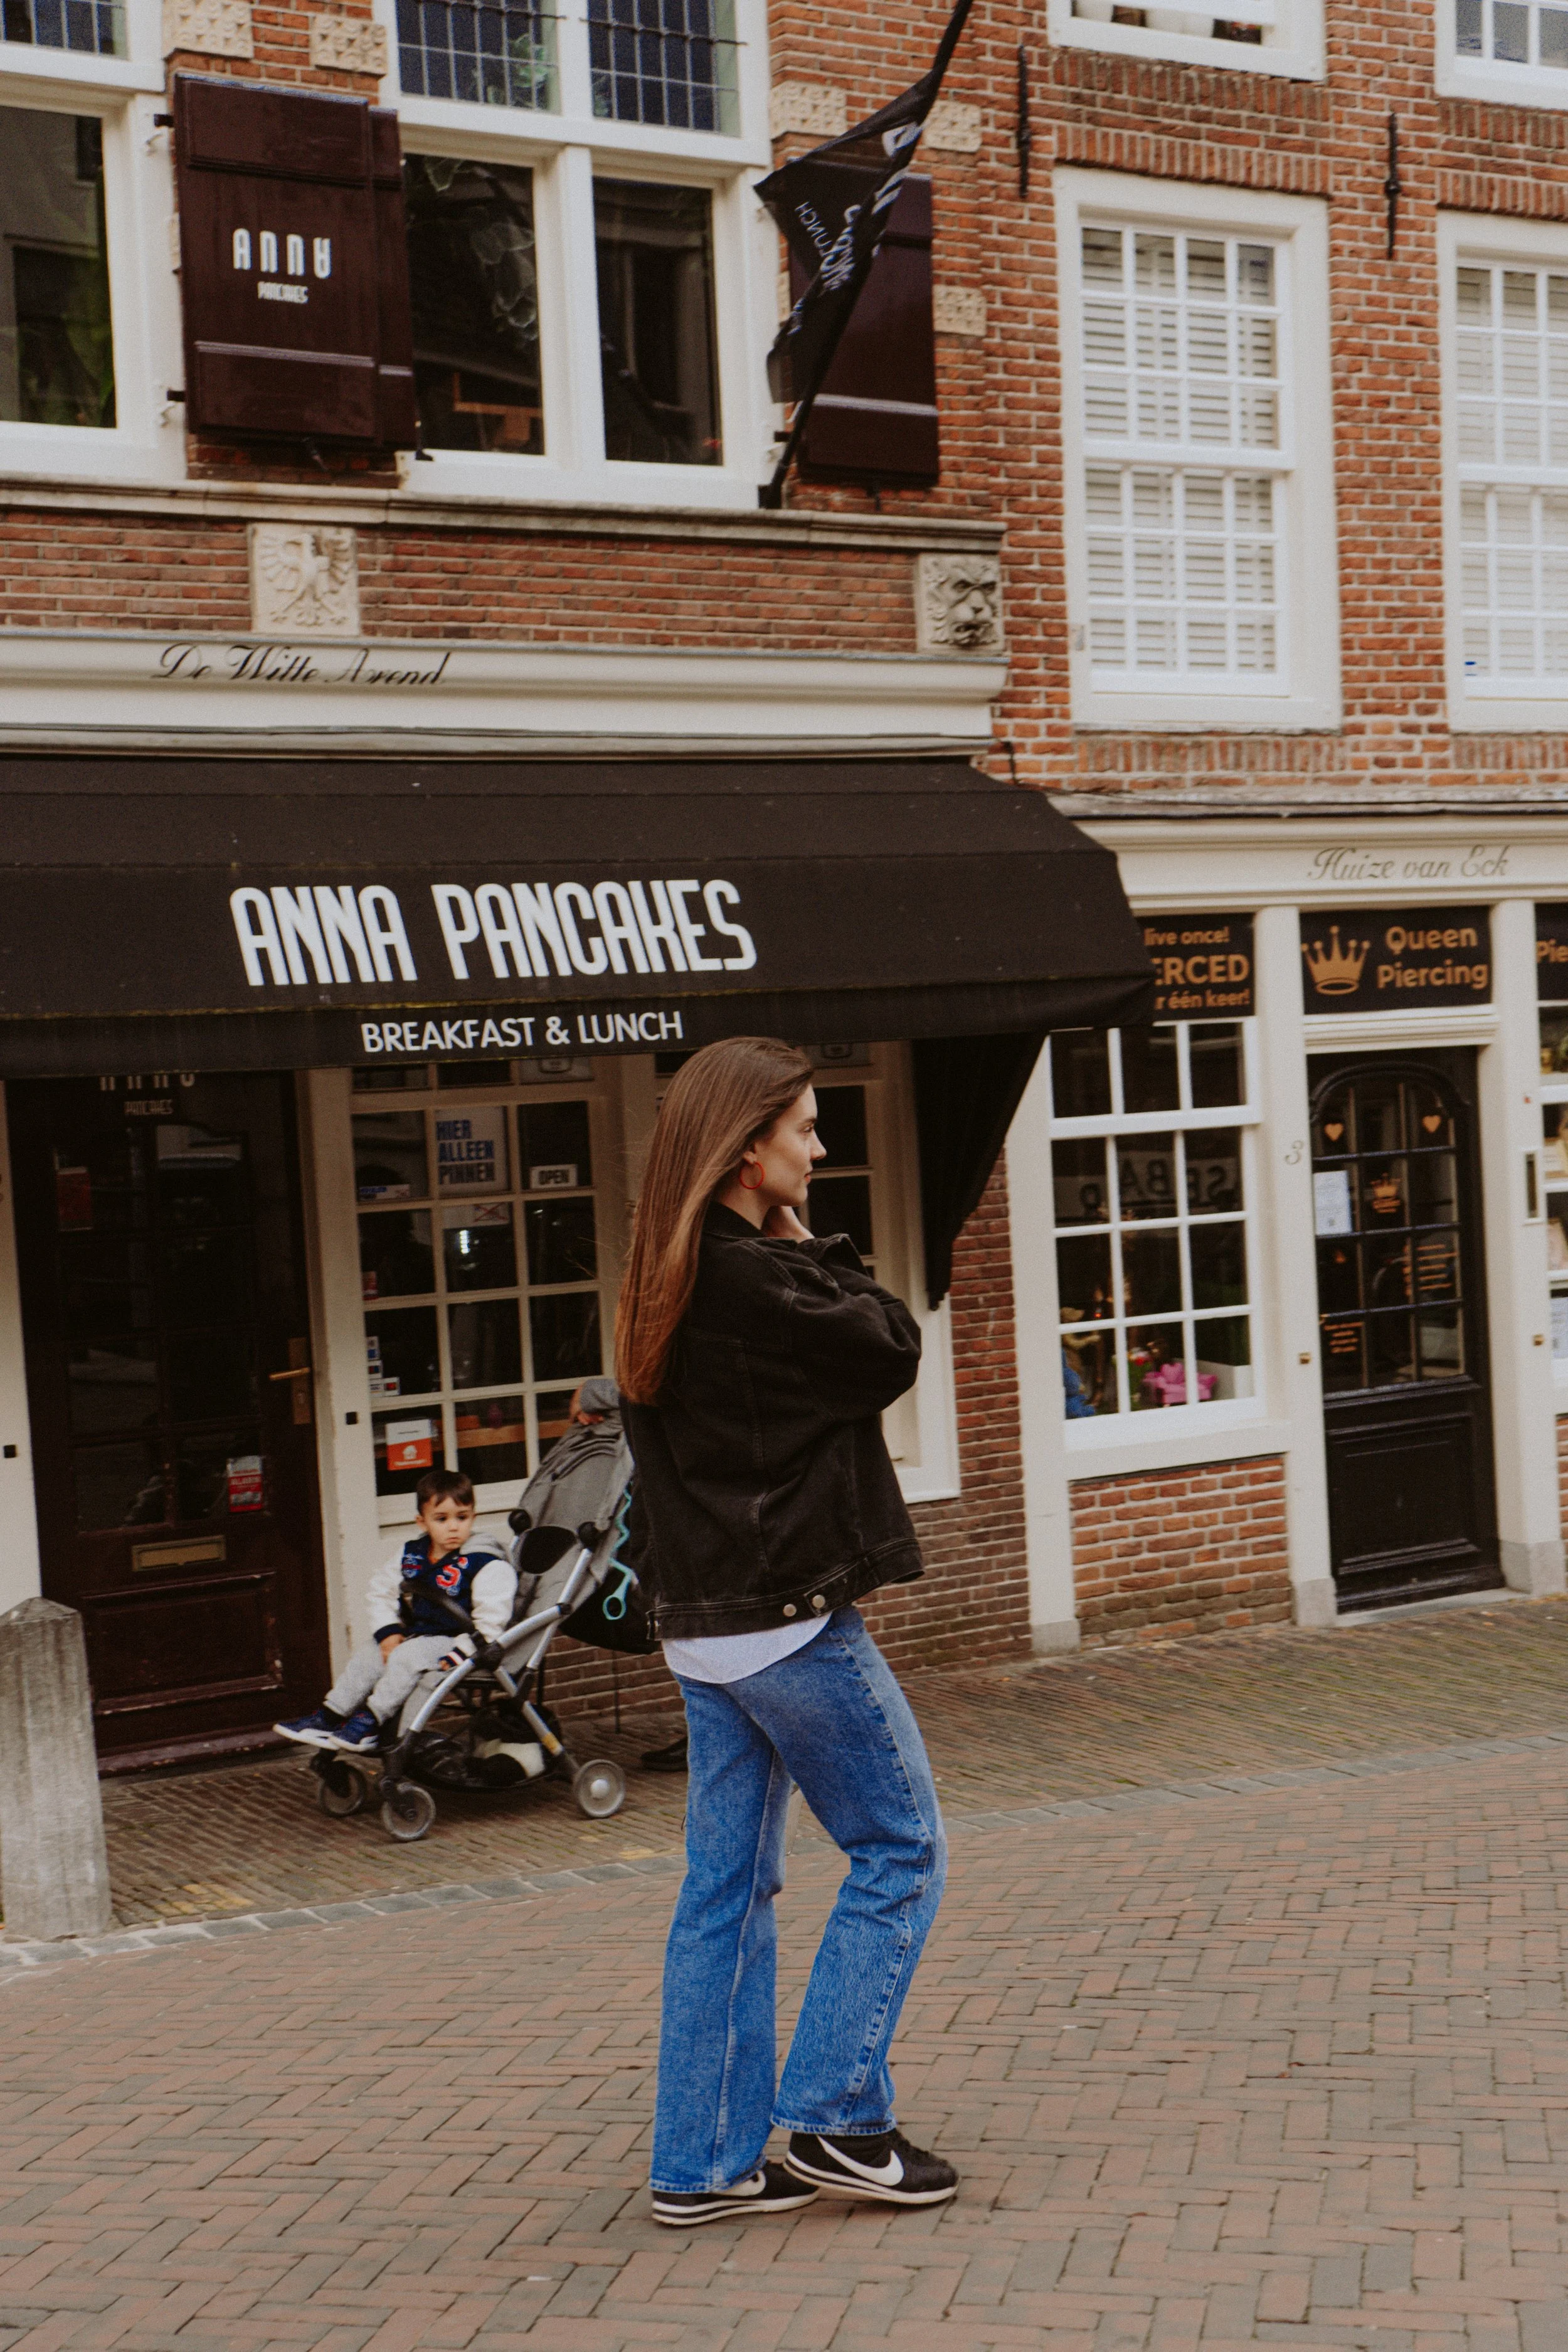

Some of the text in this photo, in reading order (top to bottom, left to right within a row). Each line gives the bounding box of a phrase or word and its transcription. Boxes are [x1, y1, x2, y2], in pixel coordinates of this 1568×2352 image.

[151, 642, 212, 680] De
[225, 643, 319, 683] Witte
[1308, 844, 1510, 880] Huize van Eck
[230, 879, 758, 987] ANNA PANCAKES
[1144, 926, 1230, 946] live once!
[1385, 926, 1478, 955] Queen
[1377, 958, 1488, 990] Piercing
[1167, 990, 1203, 1010] één
[1205, 988, 1251, 1008] keer!
[361, 1010, 684, 1053] BREAKFAST & LUNCH
[439, 1139, 495, 1162] ALLEEN
[1284, 1140, 1305, 1165] 3
[538, 1169, 569, 1185] OPEN
